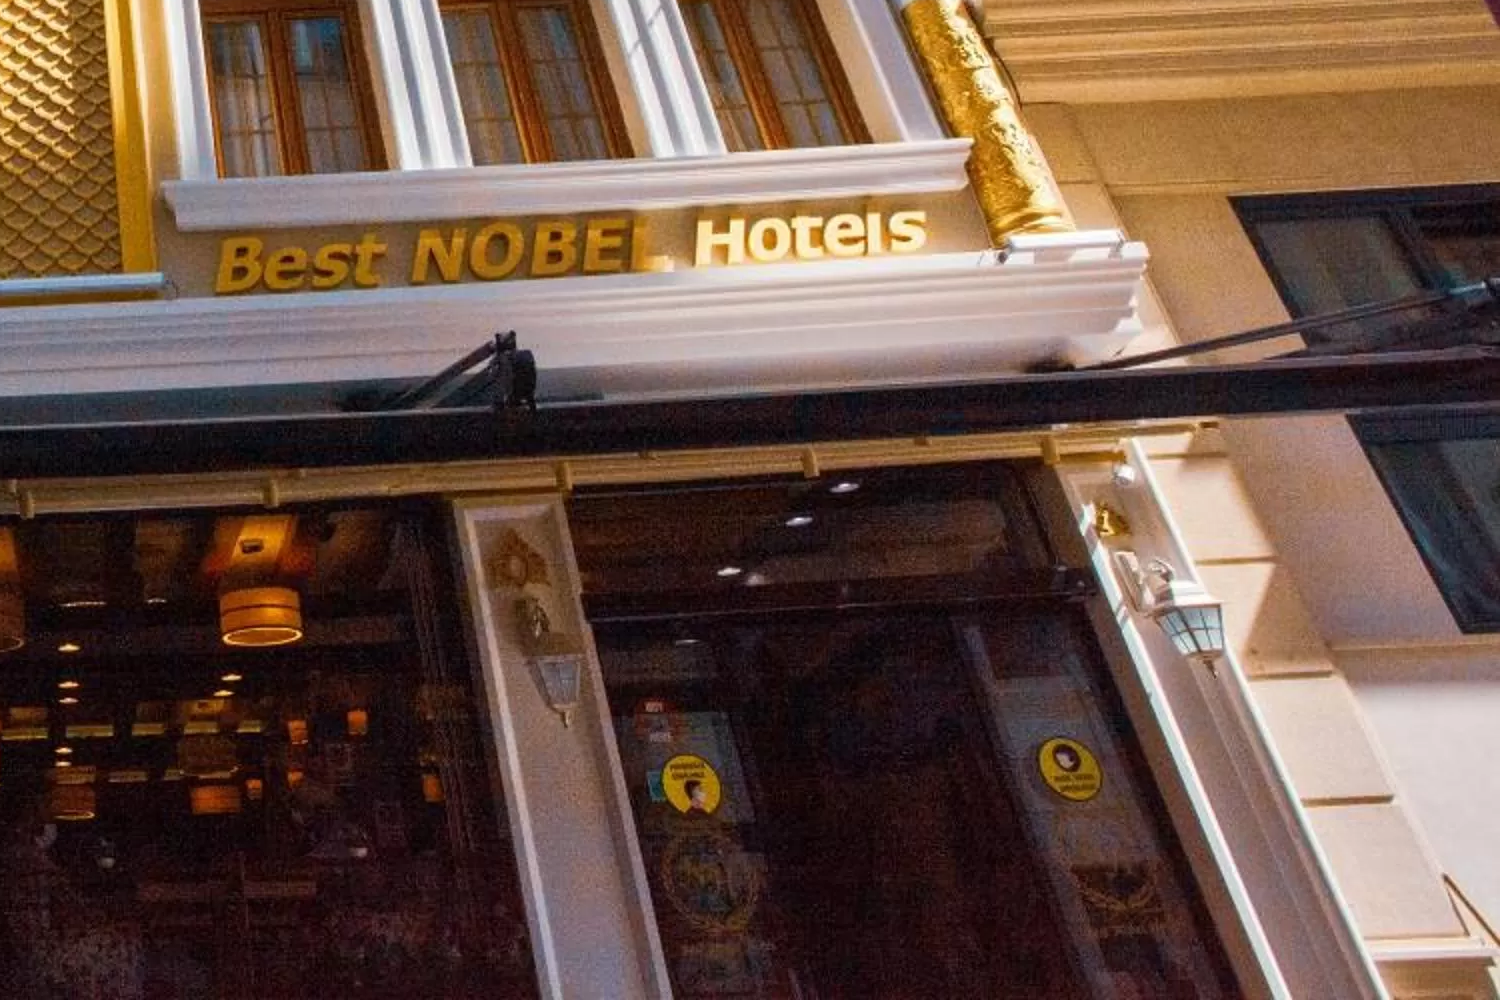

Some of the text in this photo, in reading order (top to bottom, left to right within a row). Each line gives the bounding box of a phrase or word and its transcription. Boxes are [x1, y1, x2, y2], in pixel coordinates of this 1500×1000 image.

[214, 209, 927, 294] Best NOBEL Hotels
